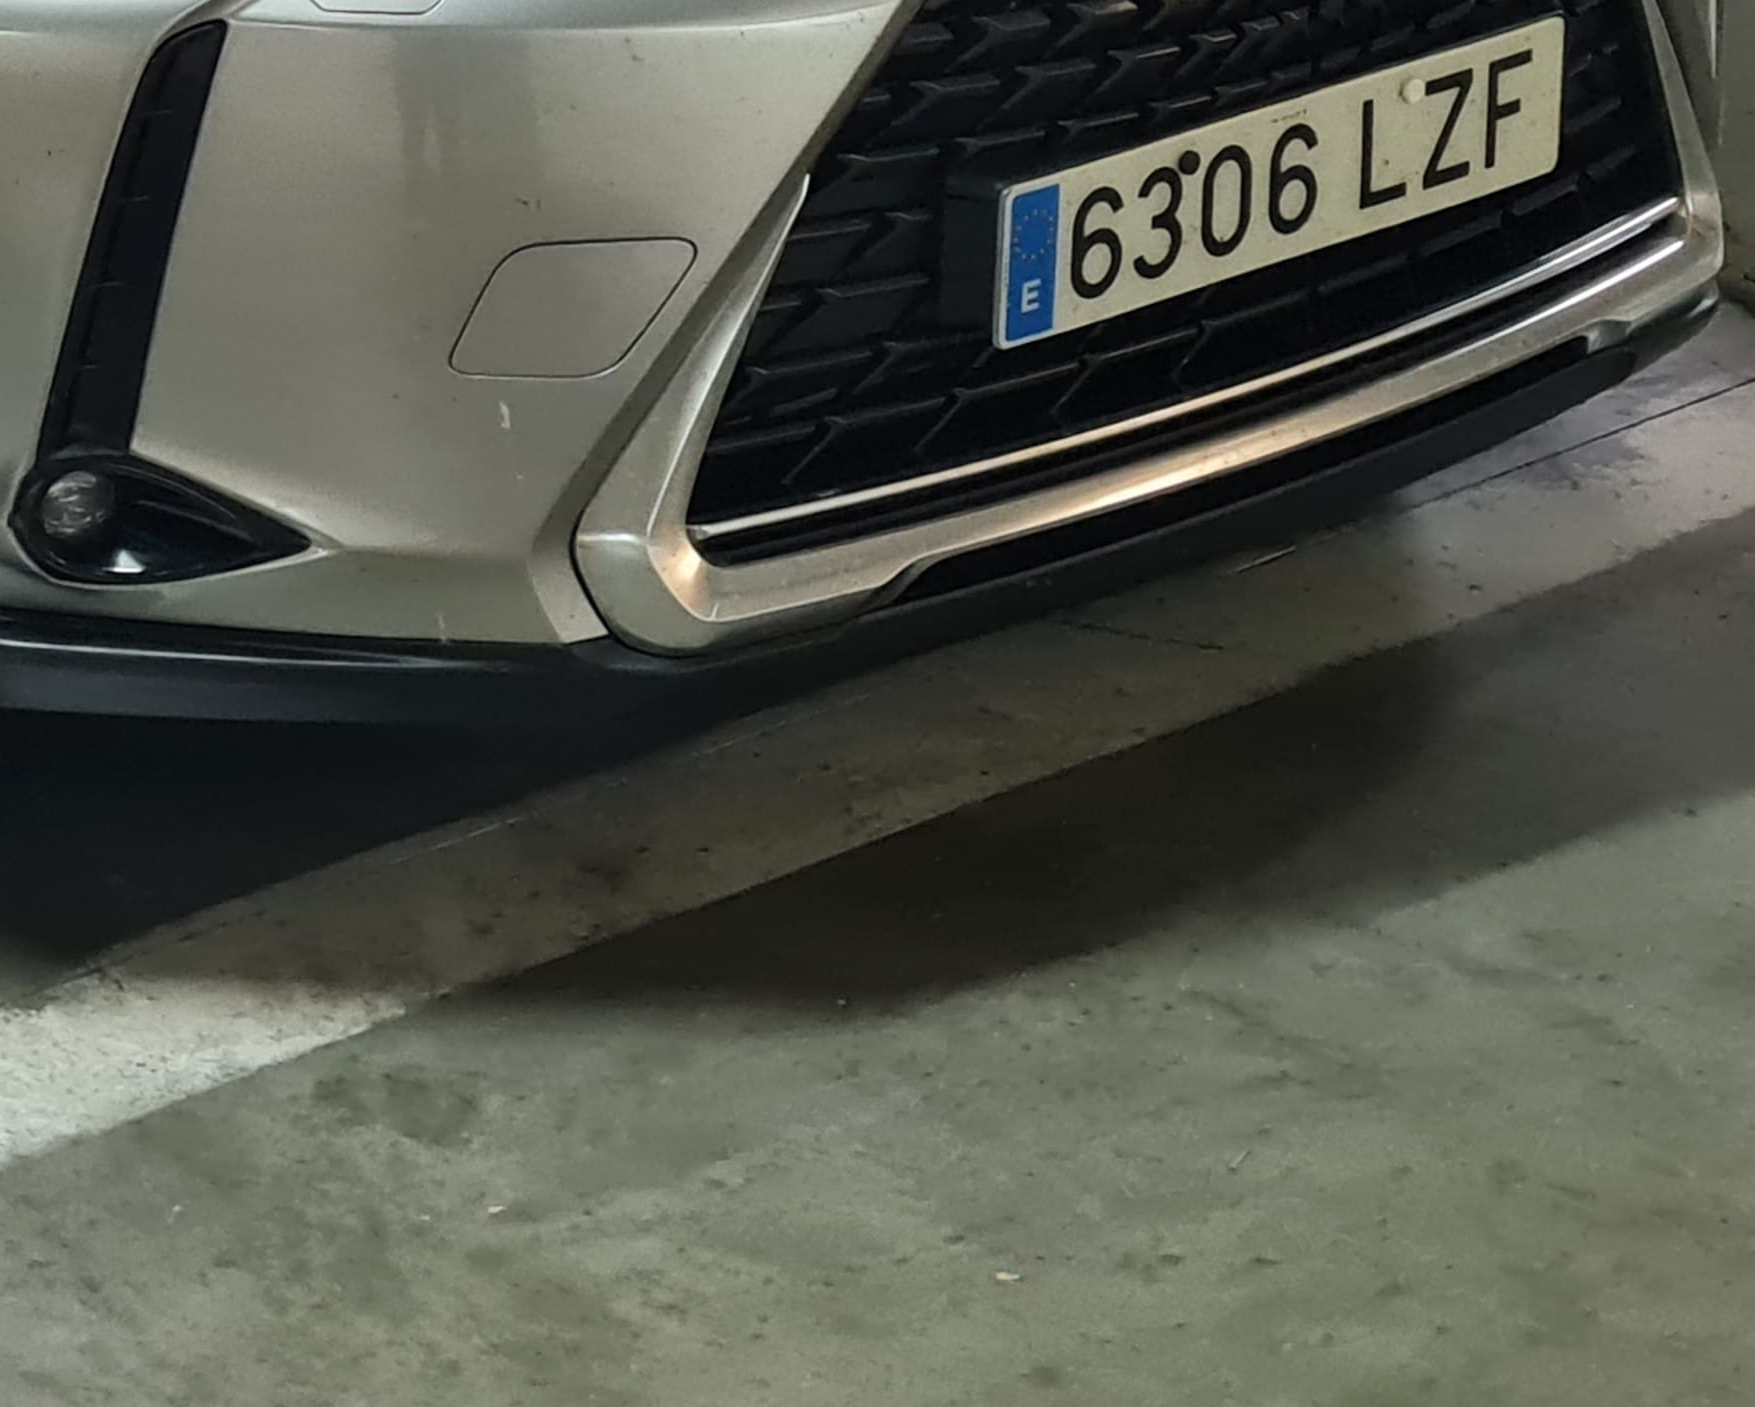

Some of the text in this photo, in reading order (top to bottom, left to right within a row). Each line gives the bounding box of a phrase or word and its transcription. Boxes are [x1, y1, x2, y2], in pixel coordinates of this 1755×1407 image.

[1070, 49, 1533, 300] 6306 LZF
[1020, 278, 1042, 313] E
